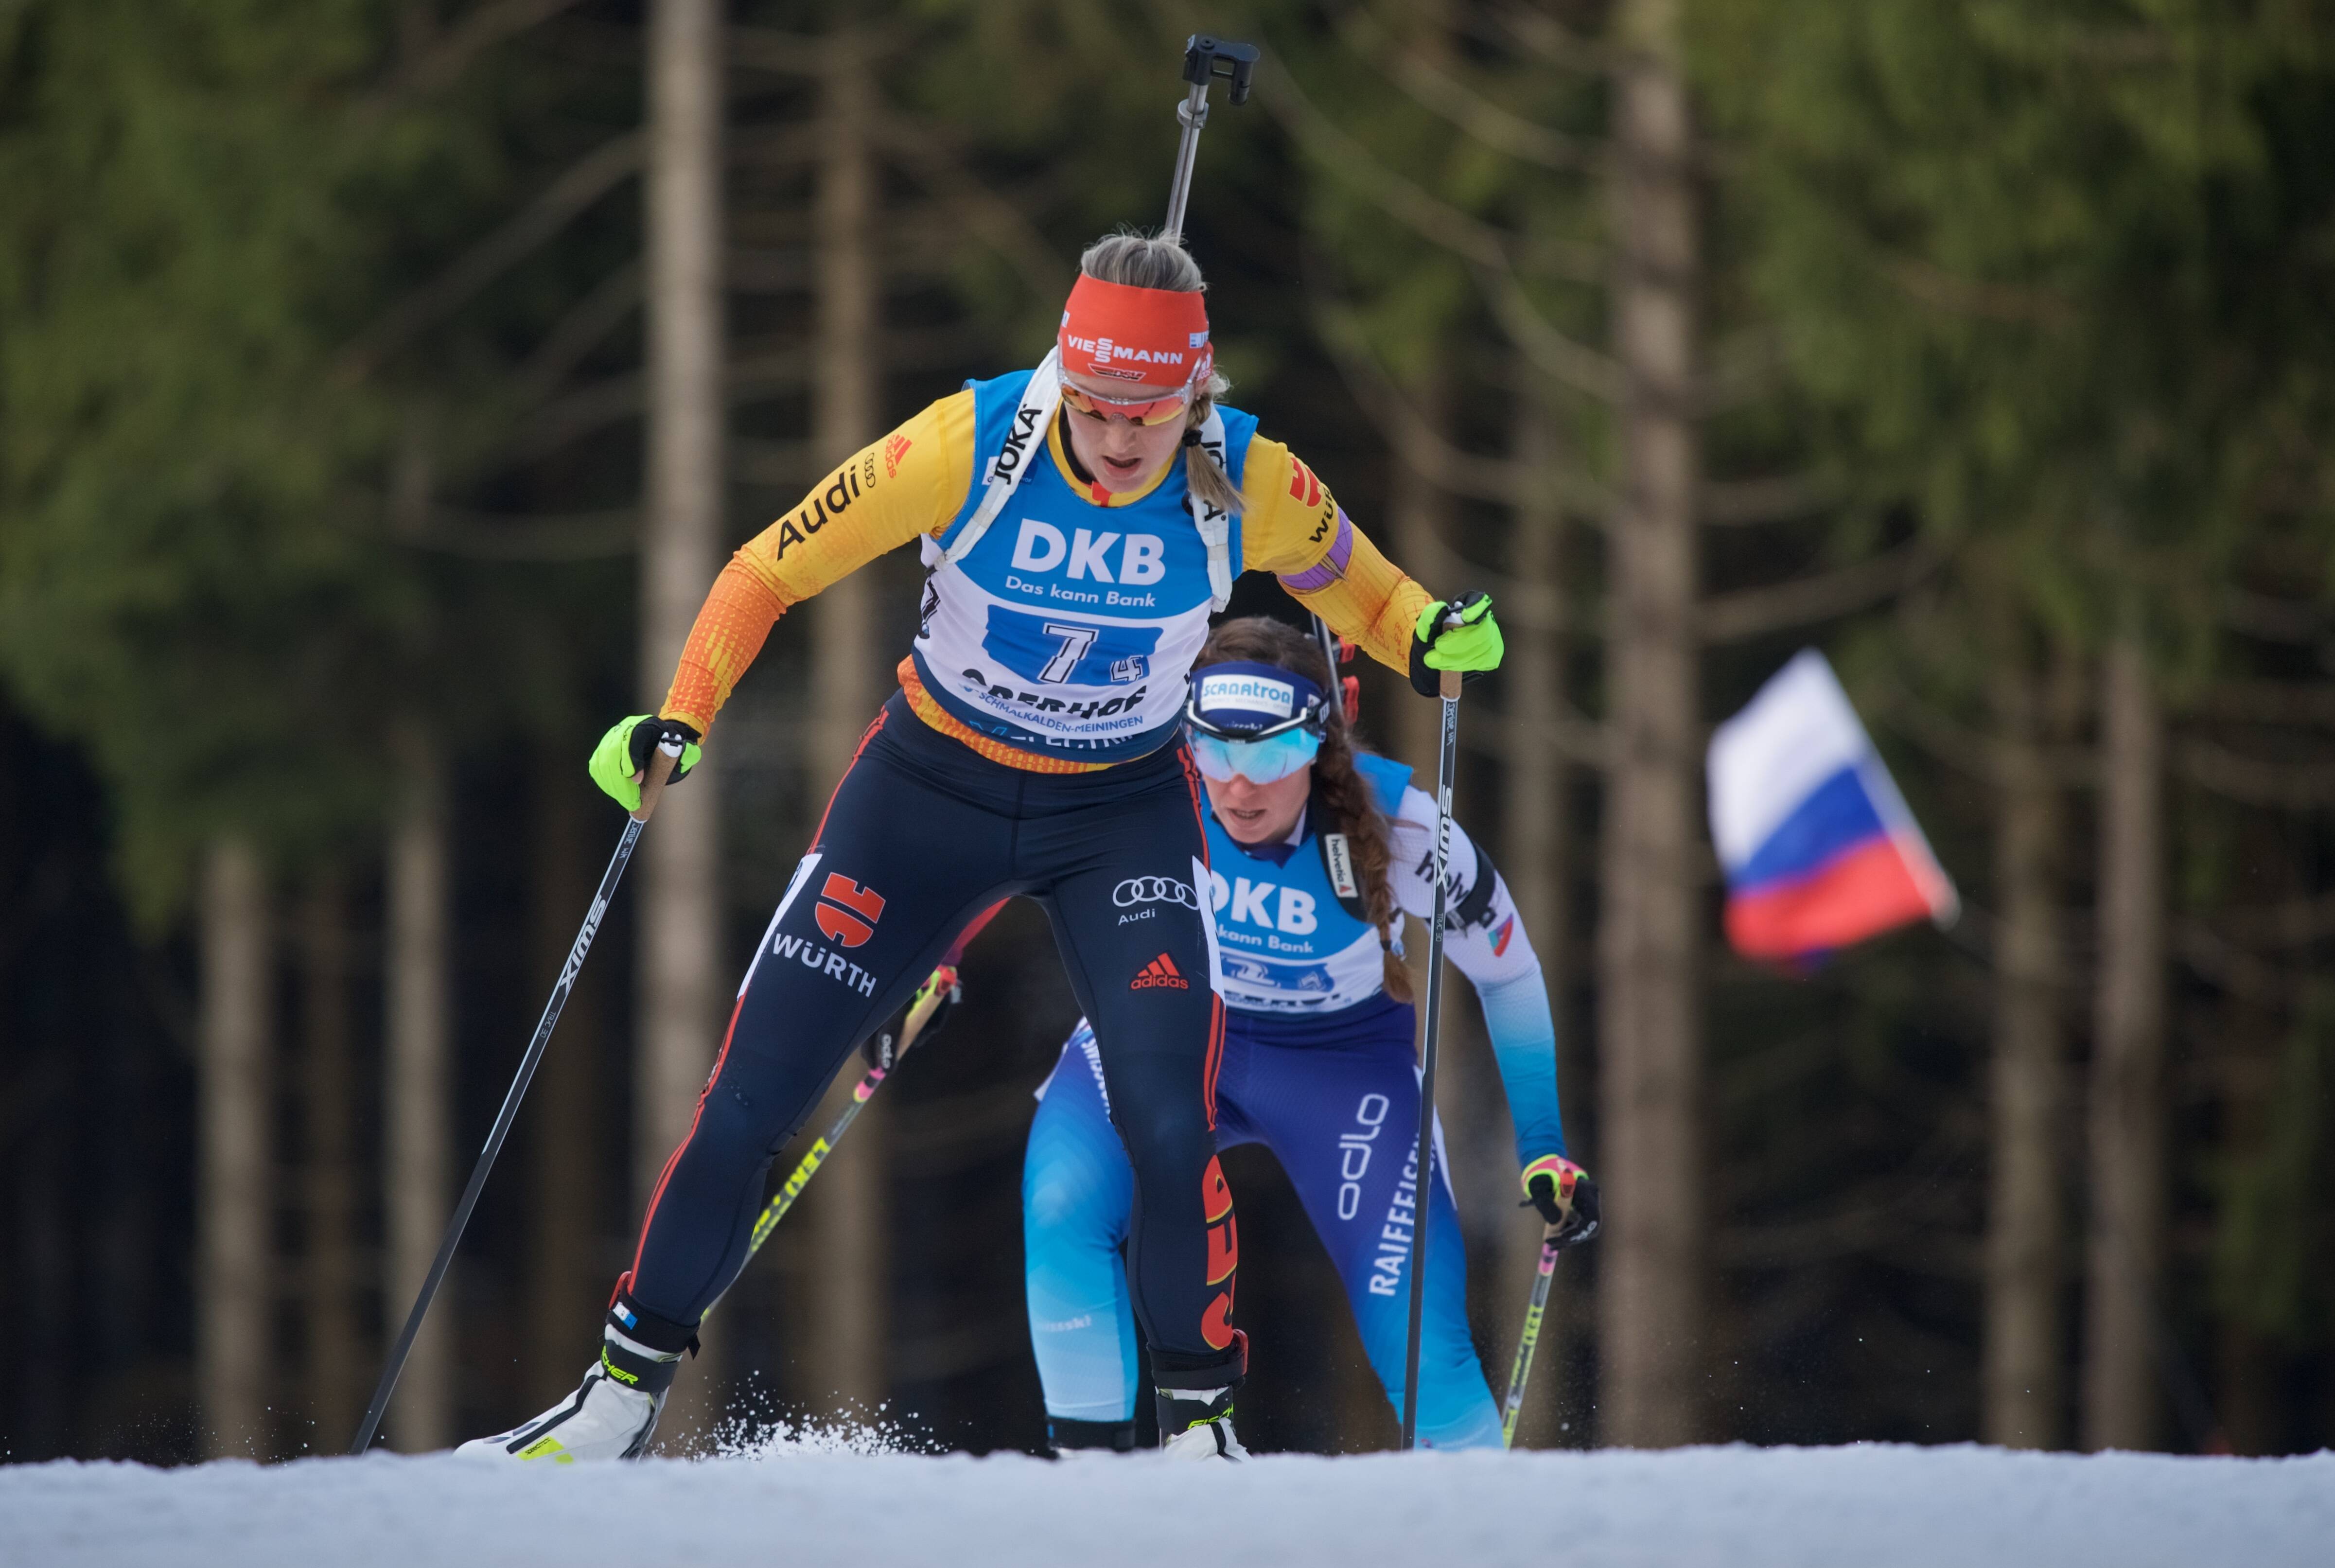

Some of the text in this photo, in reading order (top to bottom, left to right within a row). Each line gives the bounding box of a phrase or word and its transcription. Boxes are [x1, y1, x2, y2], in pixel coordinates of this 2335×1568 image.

[1068, 334, 1183, 364] VIESSMANN
[995, 408, 1043, 485] JOKA
[777, 465, 860, 561] Audi
[1011, 518, 1166, 585] DKB
[1005, 575, 1156, 607] Das kann Bank
[1038, 622, 1143, 685] 7 4
[979, 692, 1143, 732] SCHMALKALDEN-MEININGEN
[1331, 838, 1345, 883] helvetia
[1437, 784, 1452, 893] SWIX
[1415, 849, 1470, 903] hlv
[560, 895, 606, 994] SWIX
[1118, 908, 1156, 926] Audi
[1217, 924, 1314, 953] kann Bank
[773, 933, 877, 998] WÜRTH
[1131, 974, 1189, 990] adidas
[1338, 1093, 1390, 1220] odlo
